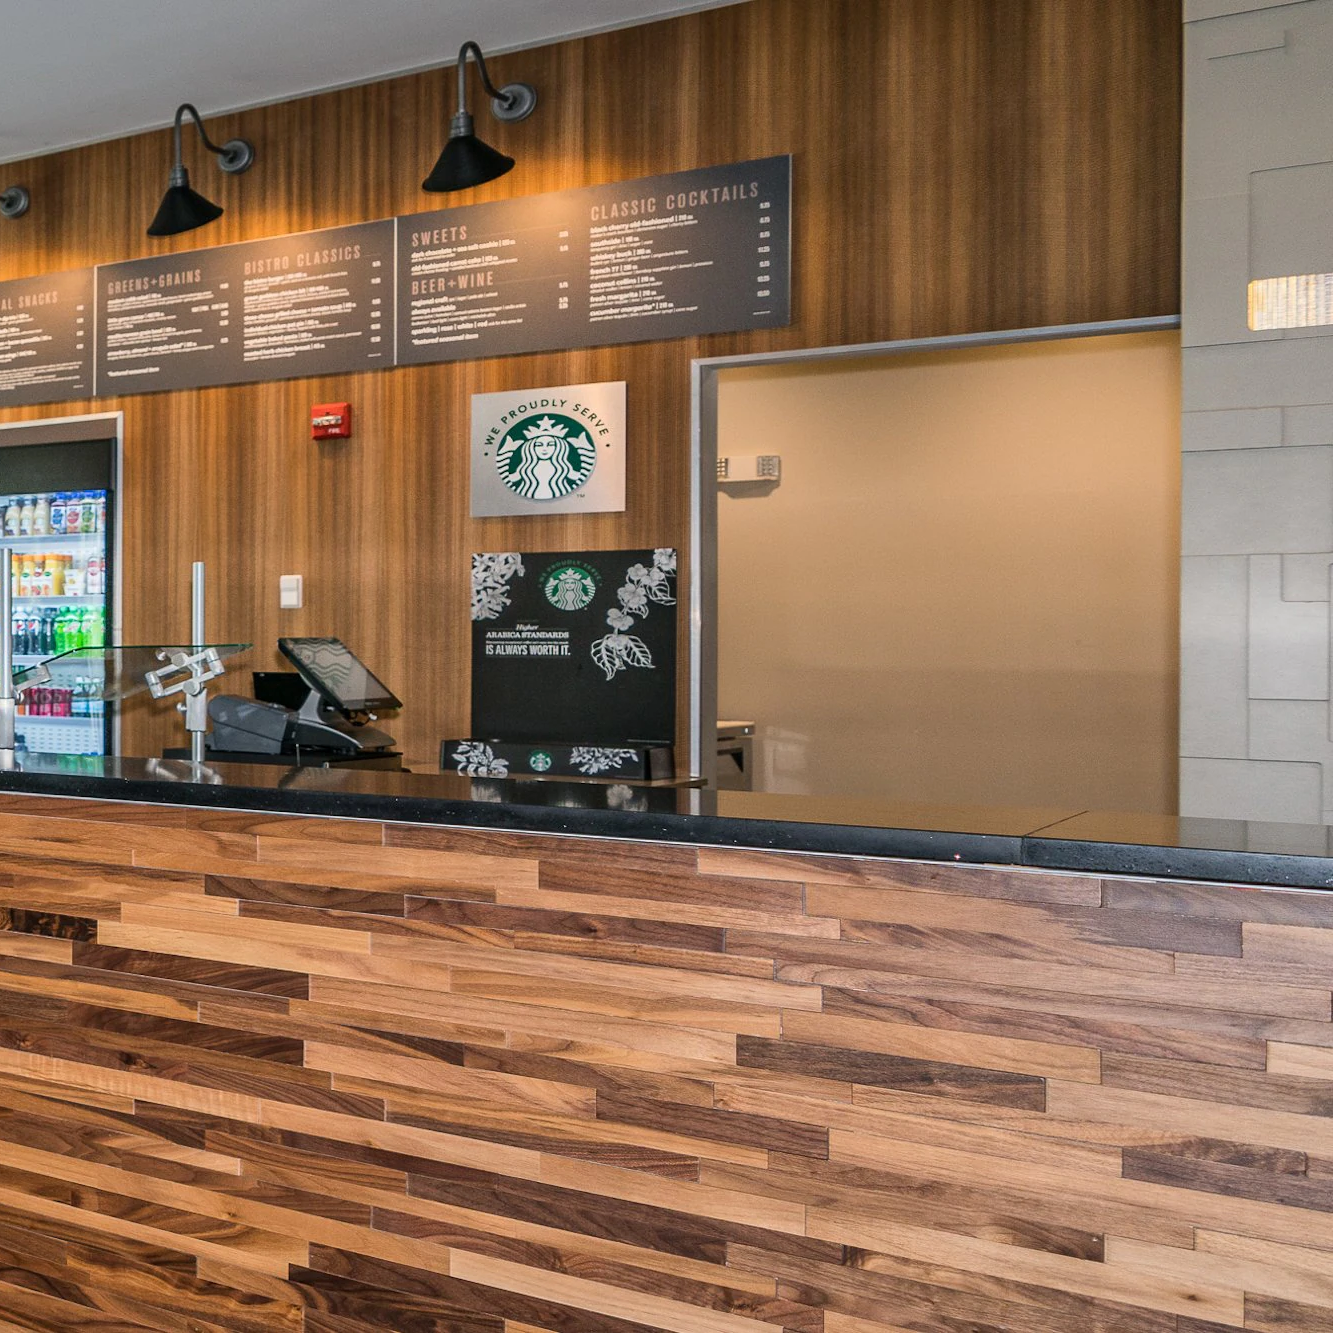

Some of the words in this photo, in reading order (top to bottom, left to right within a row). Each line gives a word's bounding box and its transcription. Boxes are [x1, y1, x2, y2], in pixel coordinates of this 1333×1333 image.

[591, 197, 656, 221] CLASSIC
[666, 182, 759, 210] COCKTAILS
[412, 225, 467, 247] SWEETS
[244, 256, 289, 275] BISTRO
[297, 245, 361, 267] CLASSICS
[107, 269, 201, 296] GREENS+GRAINS
[412, 271, 494, 296] BEER+WINE
[18, 291, 58, 309] SNACKS
[484, 427, 501, 446] WE
[500, 399, 567, 425] PROUDLY
[572, 403, 609, 436] SERVE
[485, 631, 521, 639] ARABICA
[521, 631, 570, 639] STANDARDS
[515, 623, 539, 631] Higher
[486, 645, 494, 655] IS
[495, 645, 528, 655] ALWAYS
[529, 645, 559, 656] WORTH
[560, 645, 571, 656] IT.
